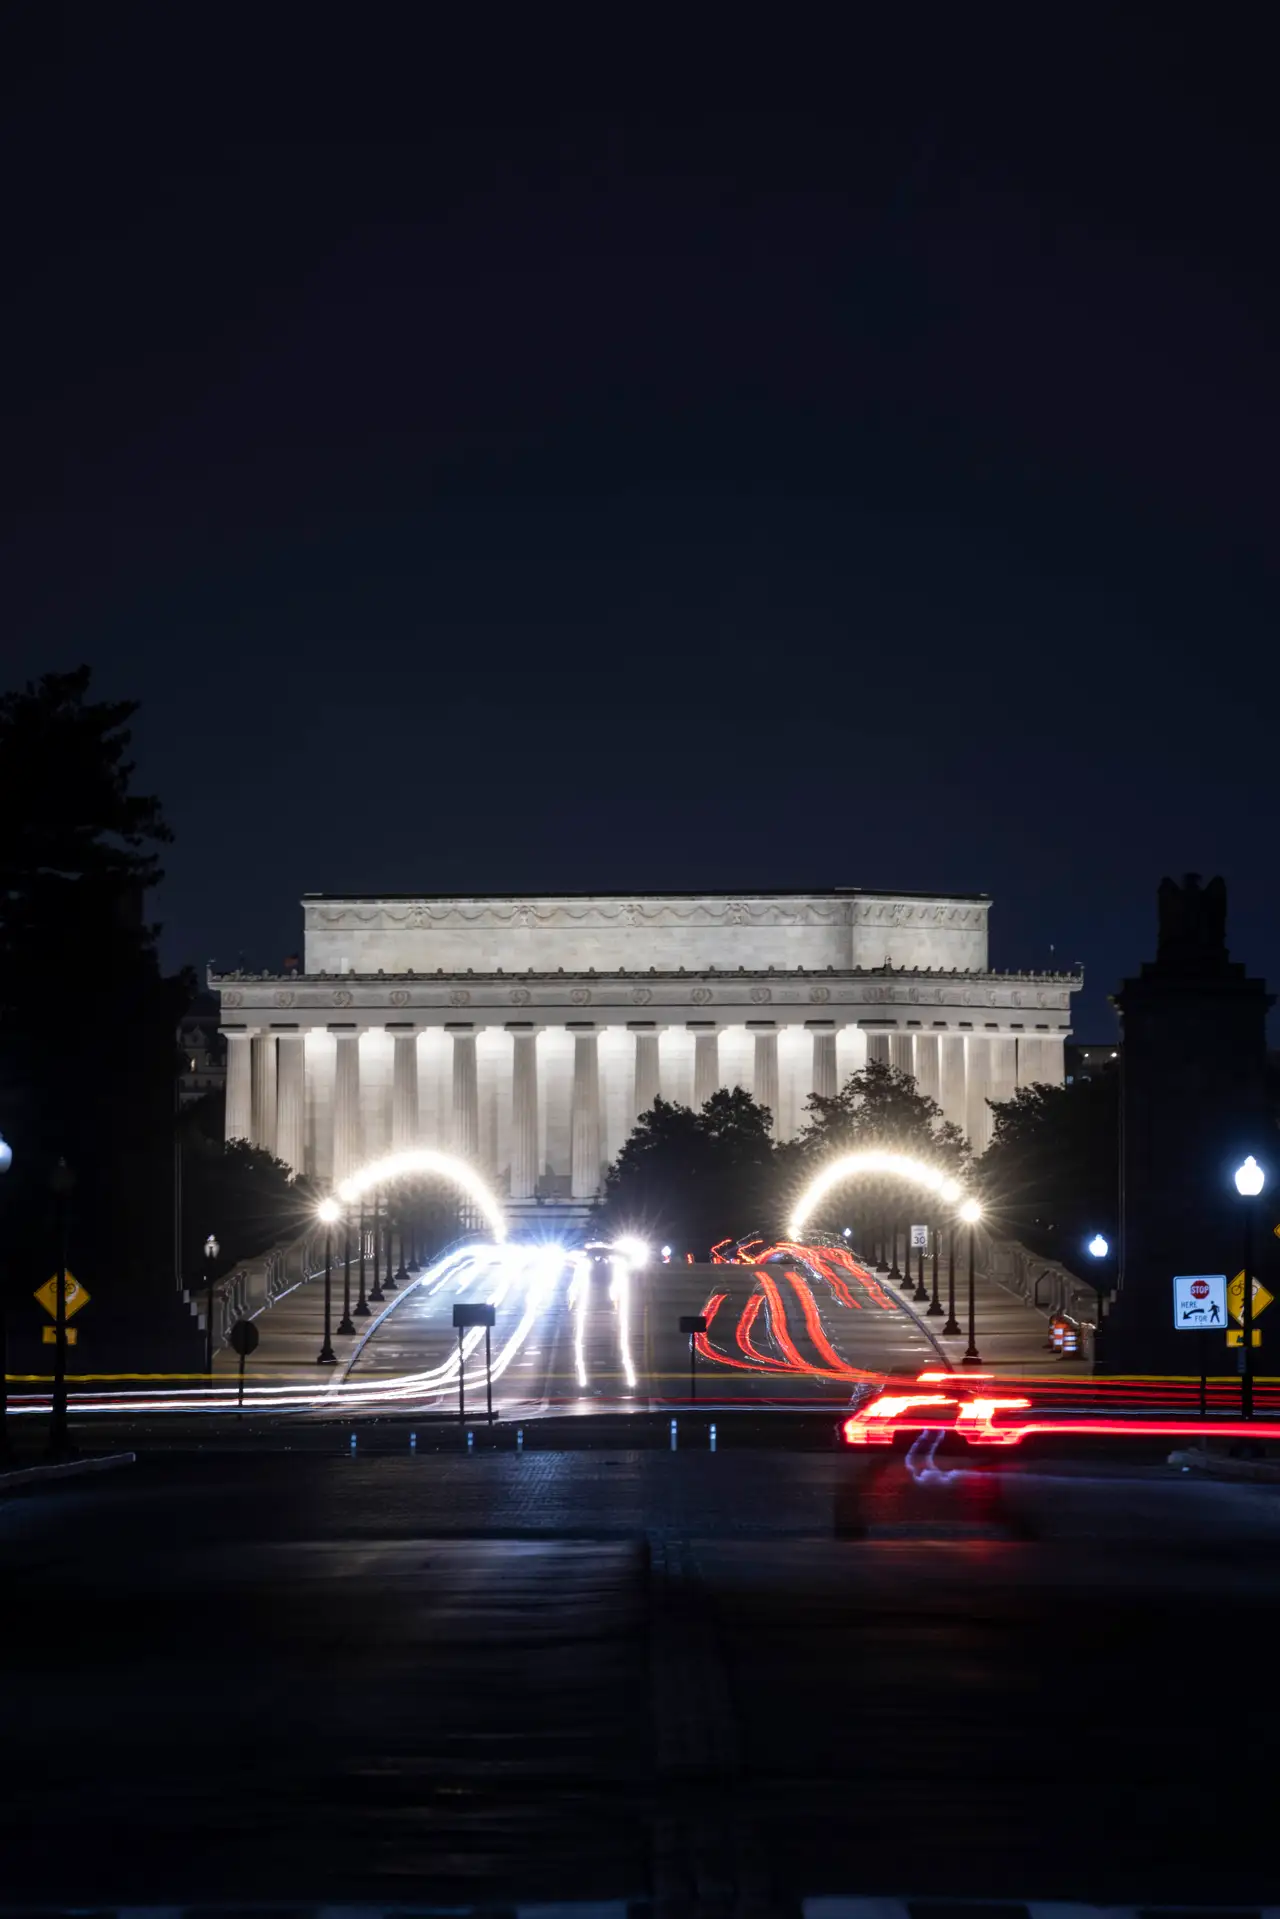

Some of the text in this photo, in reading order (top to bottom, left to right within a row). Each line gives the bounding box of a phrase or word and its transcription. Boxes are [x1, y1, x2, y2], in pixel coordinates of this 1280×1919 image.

[913, 1235, 926, 1245] 30
[1191, 1285, 1209, 1295] STOP
[1180, 1300, 1198, 1309] HERE
[1194, 1314, 1208, 1323] FOR
